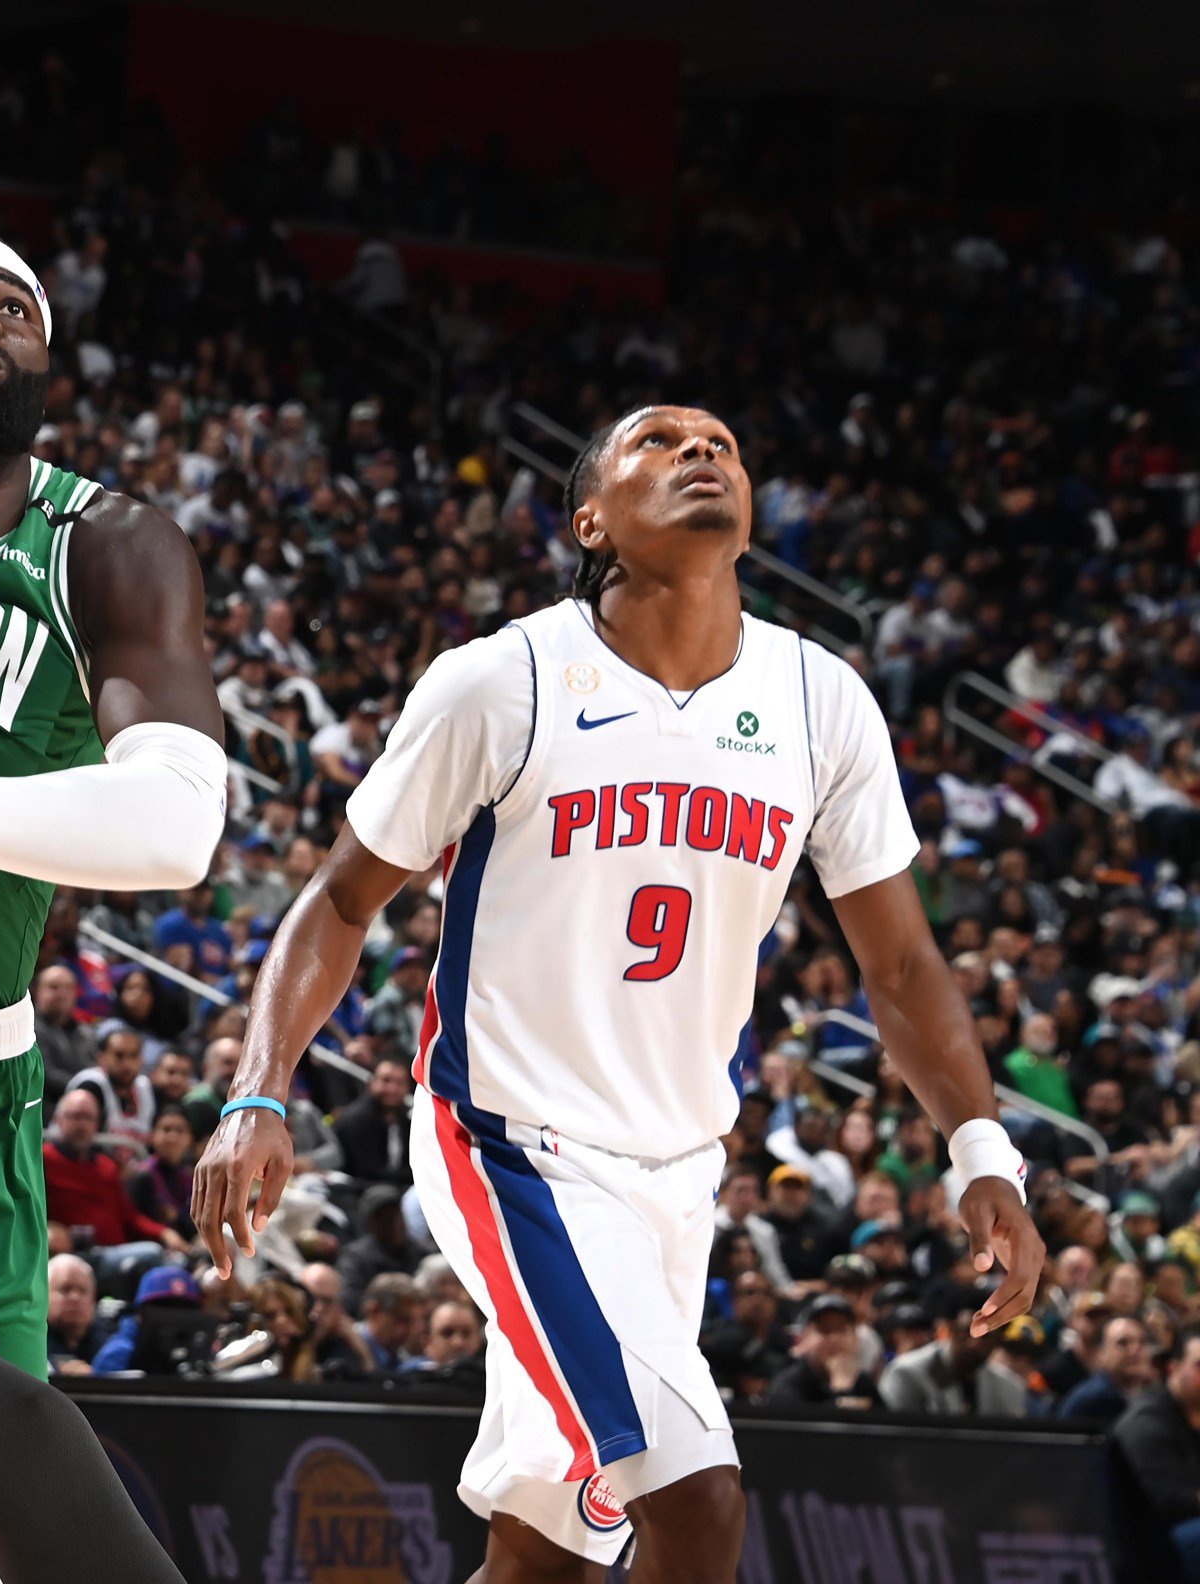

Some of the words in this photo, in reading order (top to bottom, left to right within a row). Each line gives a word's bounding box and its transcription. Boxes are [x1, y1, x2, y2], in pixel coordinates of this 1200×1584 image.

[716, 736, 776, 756] StockX
[548, 782, 794, 871] PISTONS
[623, 884, 693, 982] 9
